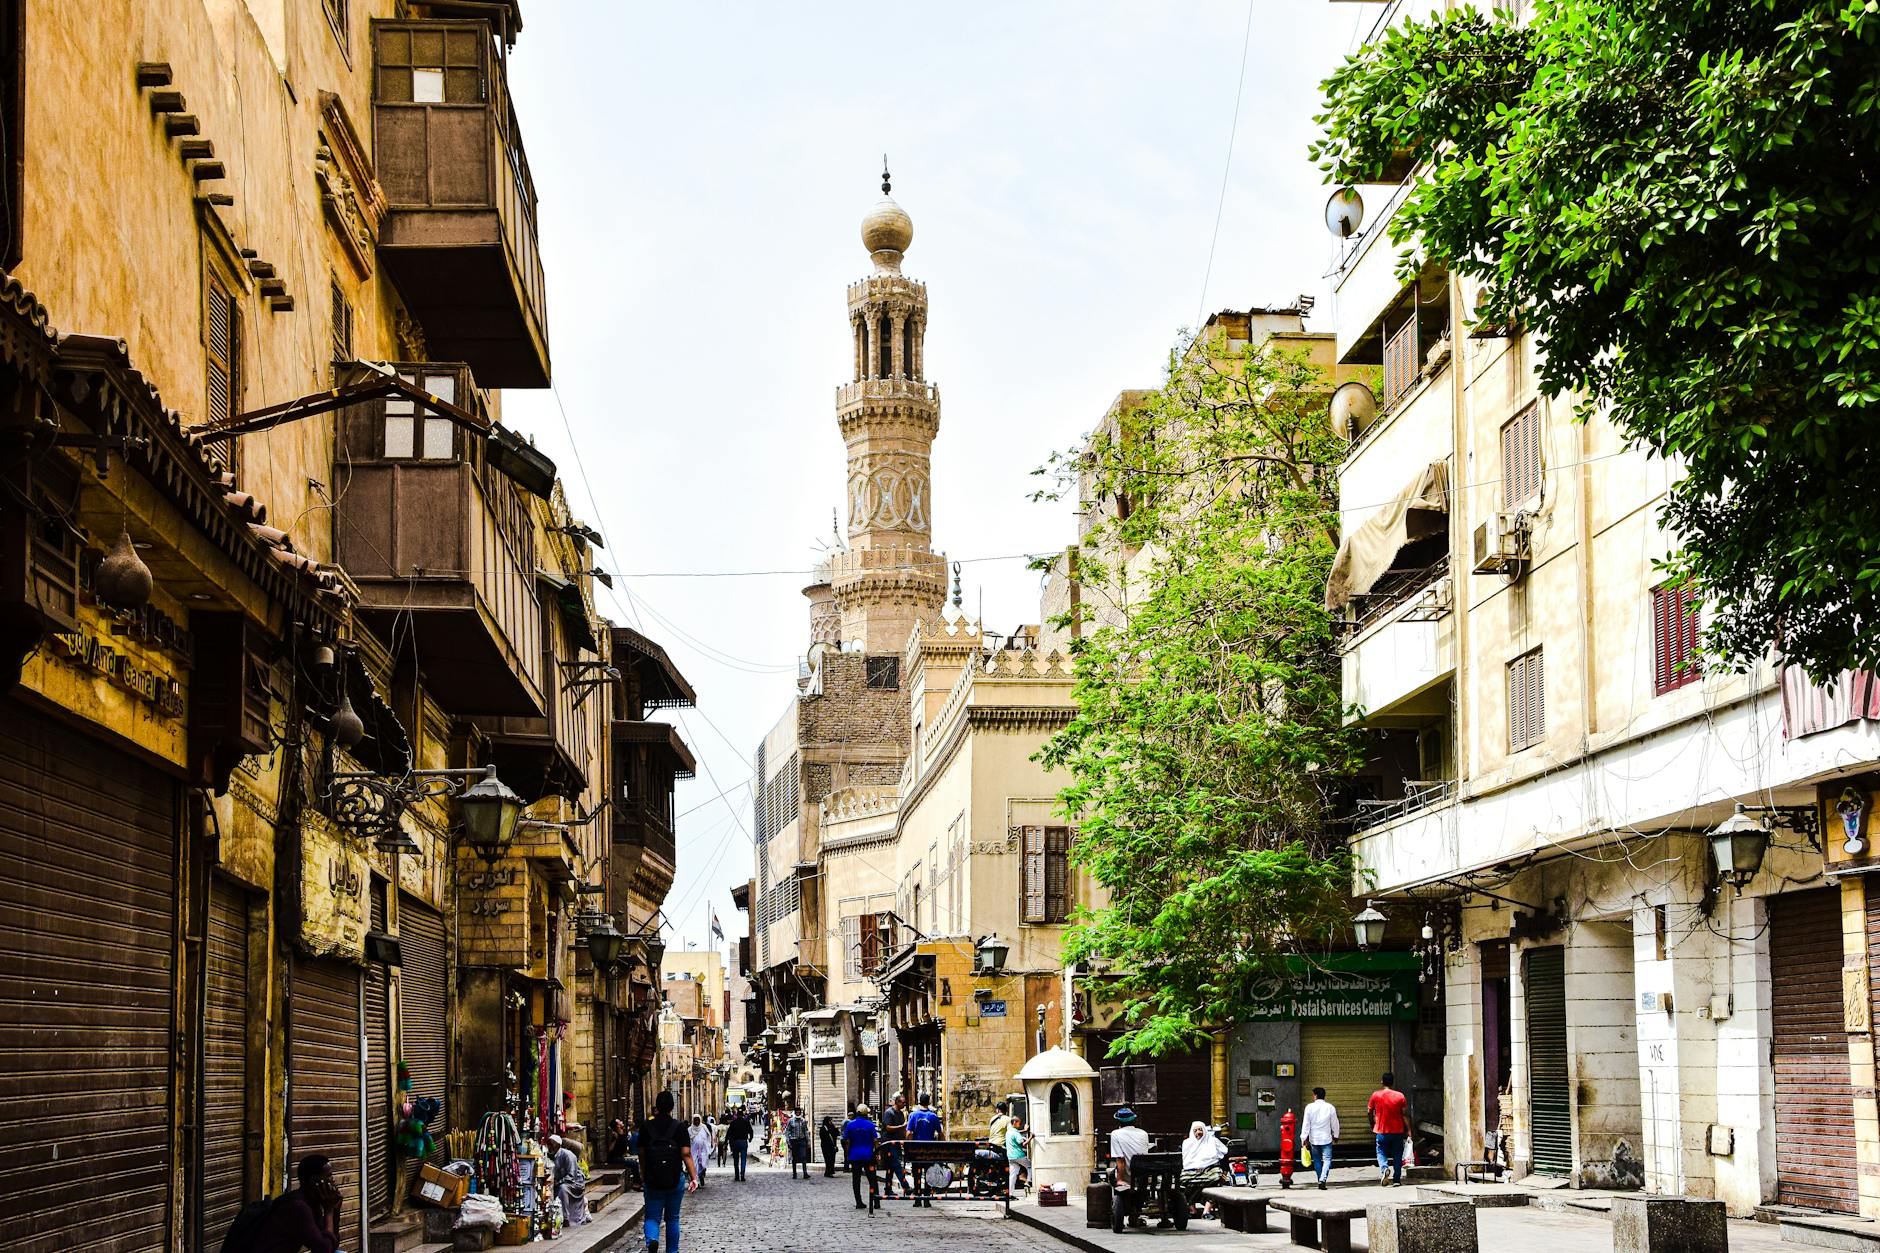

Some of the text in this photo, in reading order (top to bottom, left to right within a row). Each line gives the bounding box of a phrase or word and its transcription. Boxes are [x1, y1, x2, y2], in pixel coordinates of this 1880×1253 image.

[92, 638, 117, 677] And
[122, 656, 157, 701] Gamal
[1291, 998, 1393, 1016] Postal Services Center
